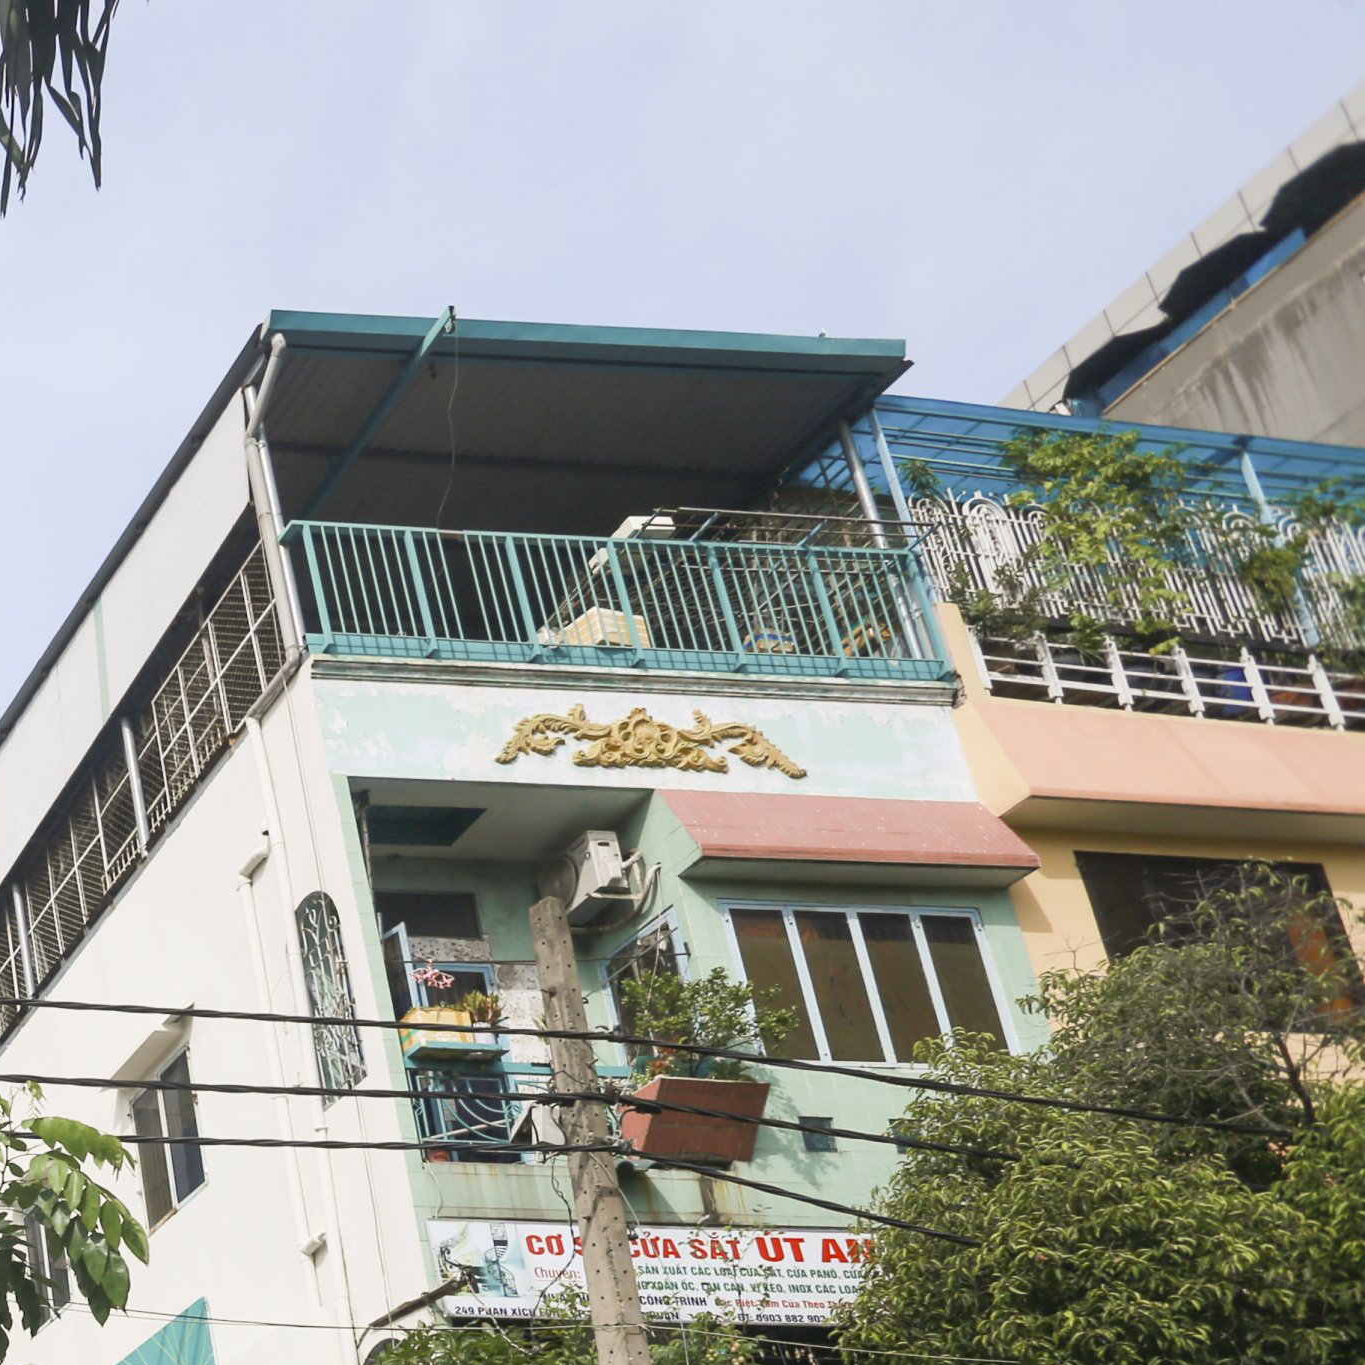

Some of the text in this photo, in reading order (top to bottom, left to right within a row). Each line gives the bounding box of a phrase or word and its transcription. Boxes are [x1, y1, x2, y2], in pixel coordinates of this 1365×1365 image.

[526, 1233, 566, 1256] CƠ
[754, 1230, 806, 1263] ÚT
[788, 1284, 813, 1294] INOX
[454, 1306, 476, 1316] 249
[784, 1315, 804, 1323] 882
